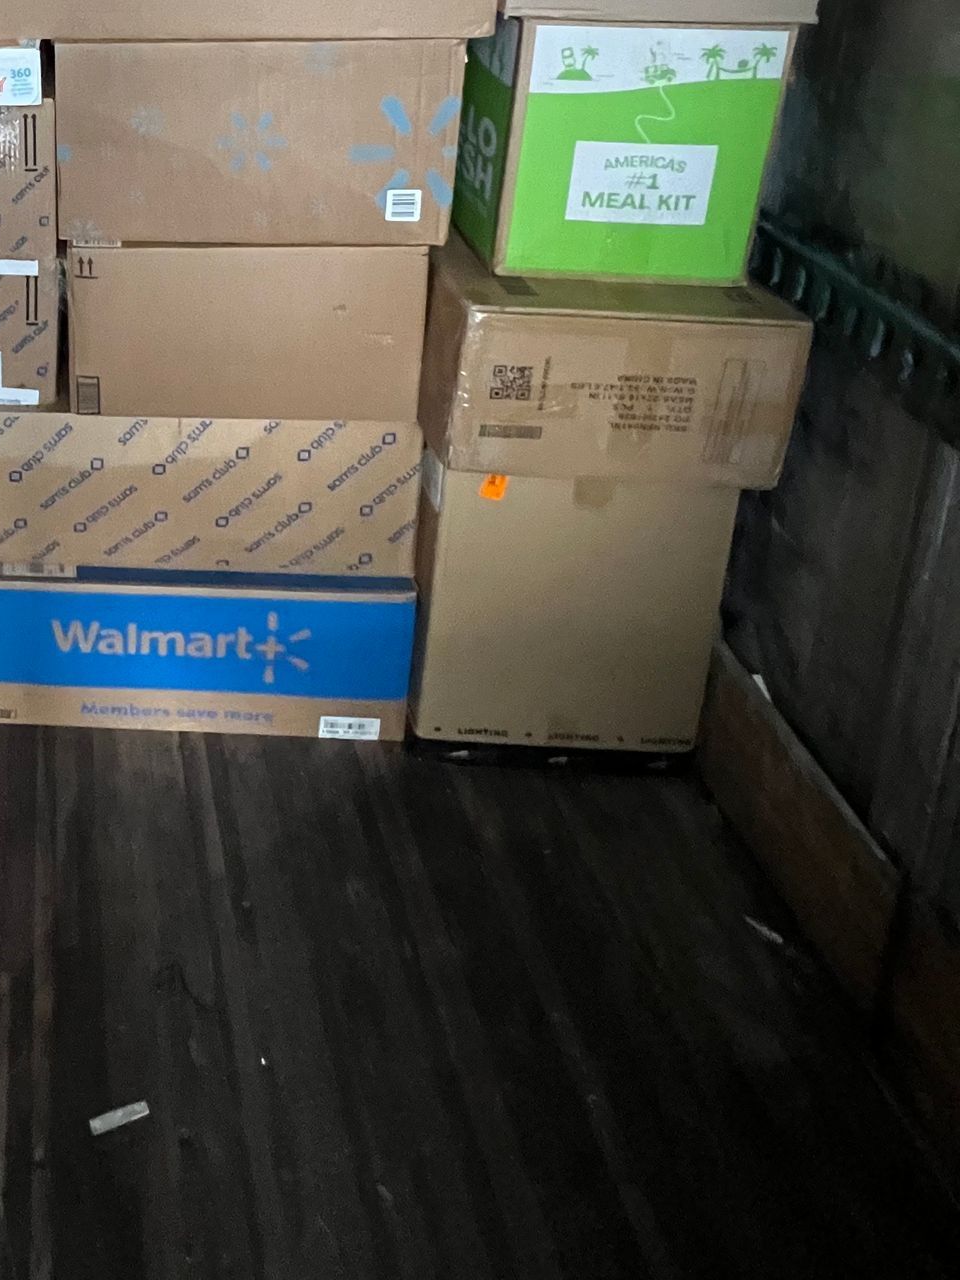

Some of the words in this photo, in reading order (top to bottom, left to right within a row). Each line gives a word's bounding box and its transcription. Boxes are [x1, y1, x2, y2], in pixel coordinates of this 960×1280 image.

[10, 67, 32, 78] 360
[625, 171, 660, 190] #1
[581, 191, 650, 210] MEAL
[657, 194, 696, 211] KIT
[310, 426, 336, 450] club
[21, 450, 44, 472] club
[165, 440, 189, 464] club
[357, 444, 383, 468] club
[68, 469, 92, 490] club
[212, 458, 237, 481] club
[372, 484, 398, 506] club
[86, 504, 110, 524] club
[228, 496, 253, 518] club
[132, 520, 156, 539] club
[274, 512, 300, 534] club
[80, 702, 170, 717] Members
[177, 707, 219, 720] save
[224, 709, 274, 721] more
